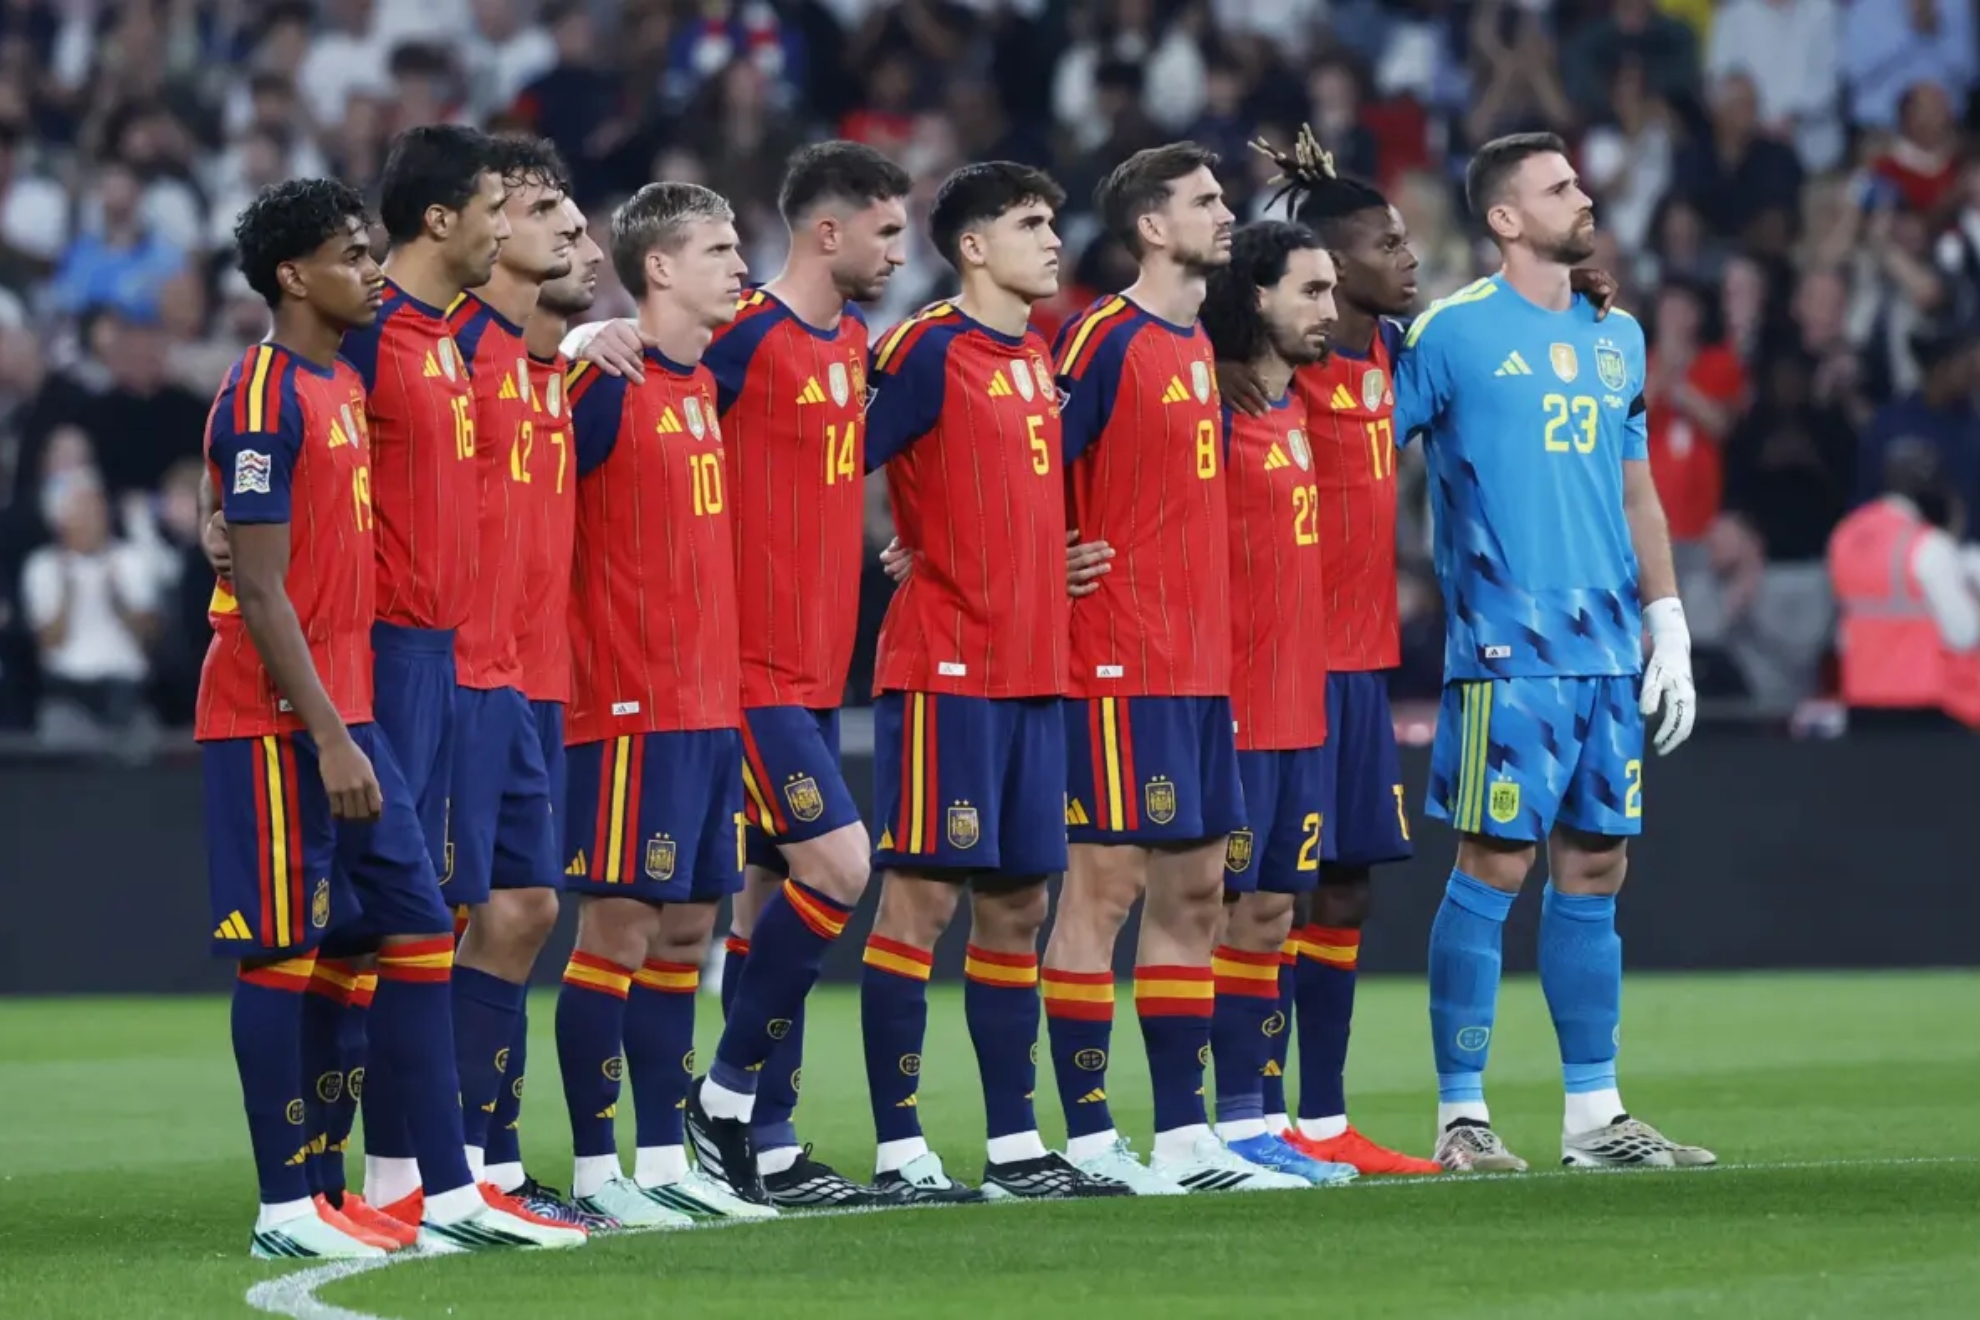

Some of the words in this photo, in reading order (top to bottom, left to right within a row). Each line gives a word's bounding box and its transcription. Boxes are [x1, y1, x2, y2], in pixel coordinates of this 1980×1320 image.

[451, 395, 474, 460] 16
[827, 421, 855, 485] 14
[1026, 415, 1049, 475] 5
[1197, 419, 1216, 479] 8
[1367, 418, 1391, 480] 17
[1543, 393, 1597, 453] 23
[551, 433, 566, 494] 7
[690, 453, 723, 516] 10
[352, 466, 372, 533] 19
[1292, 484, 1318, 546] 22
[1297, 812, 1323, 870] 2
